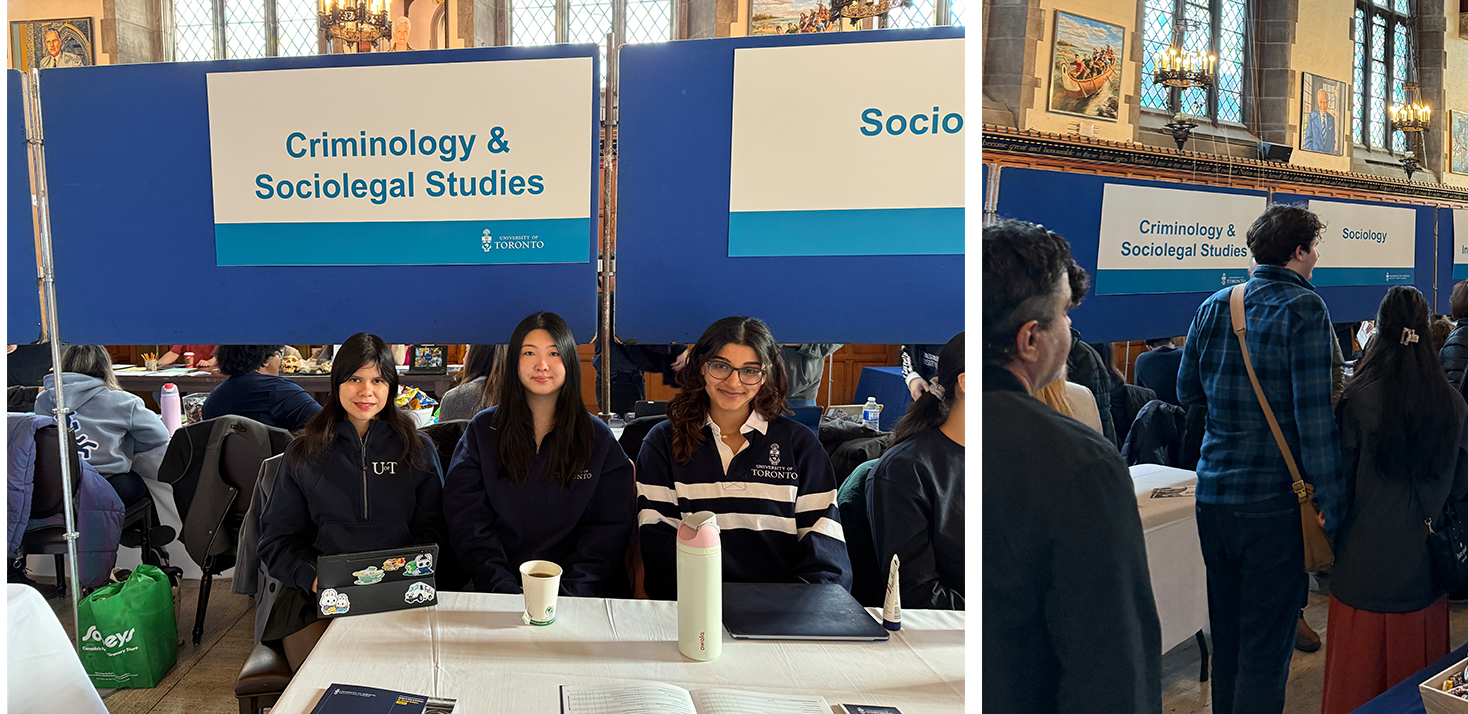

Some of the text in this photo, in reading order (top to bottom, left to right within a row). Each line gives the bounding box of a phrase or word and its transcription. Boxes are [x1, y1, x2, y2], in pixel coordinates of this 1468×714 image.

[860, 106, 964, 138] Socio
[286, 126, 510, 162] Criminology &
[254, 169, 545, 205] Sociolegal Studies
[1140, 220, 1236, 240] Criminology &
[1342, 228, 1388, 244] Sociology
[494, 241, 544, 249] TORONTO
[1121, 242, 1248, 260] Sociolegal Studies
[751, 468, 798, 480] TORONTO
[82, 626, 135, 648] Soeys
